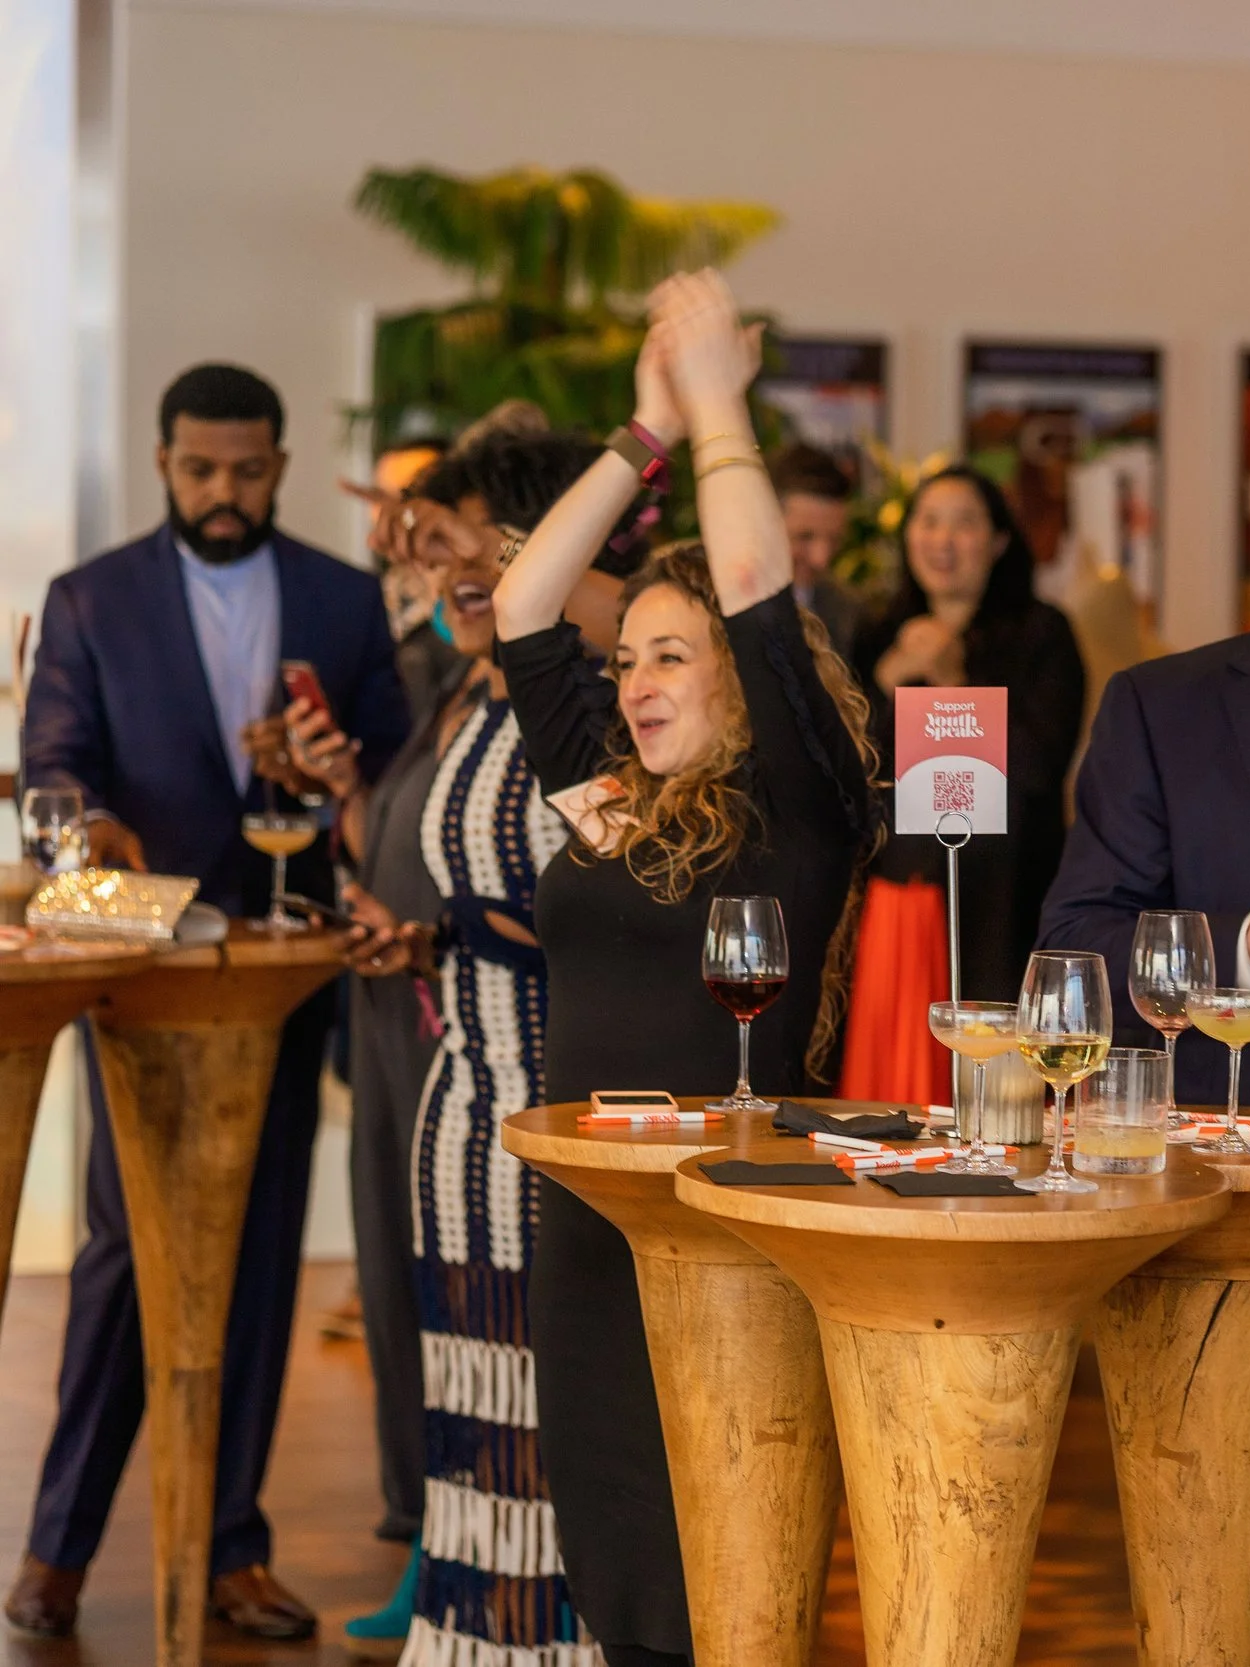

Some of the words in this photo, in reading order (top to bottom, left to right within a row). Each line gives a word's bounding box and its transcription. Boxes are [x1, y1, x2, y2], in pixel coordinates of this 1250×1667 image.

[933, 701, 976, 713] Support
[925, 712, 977, 727] Youth
[924, 724, 985, 741] Speaks
